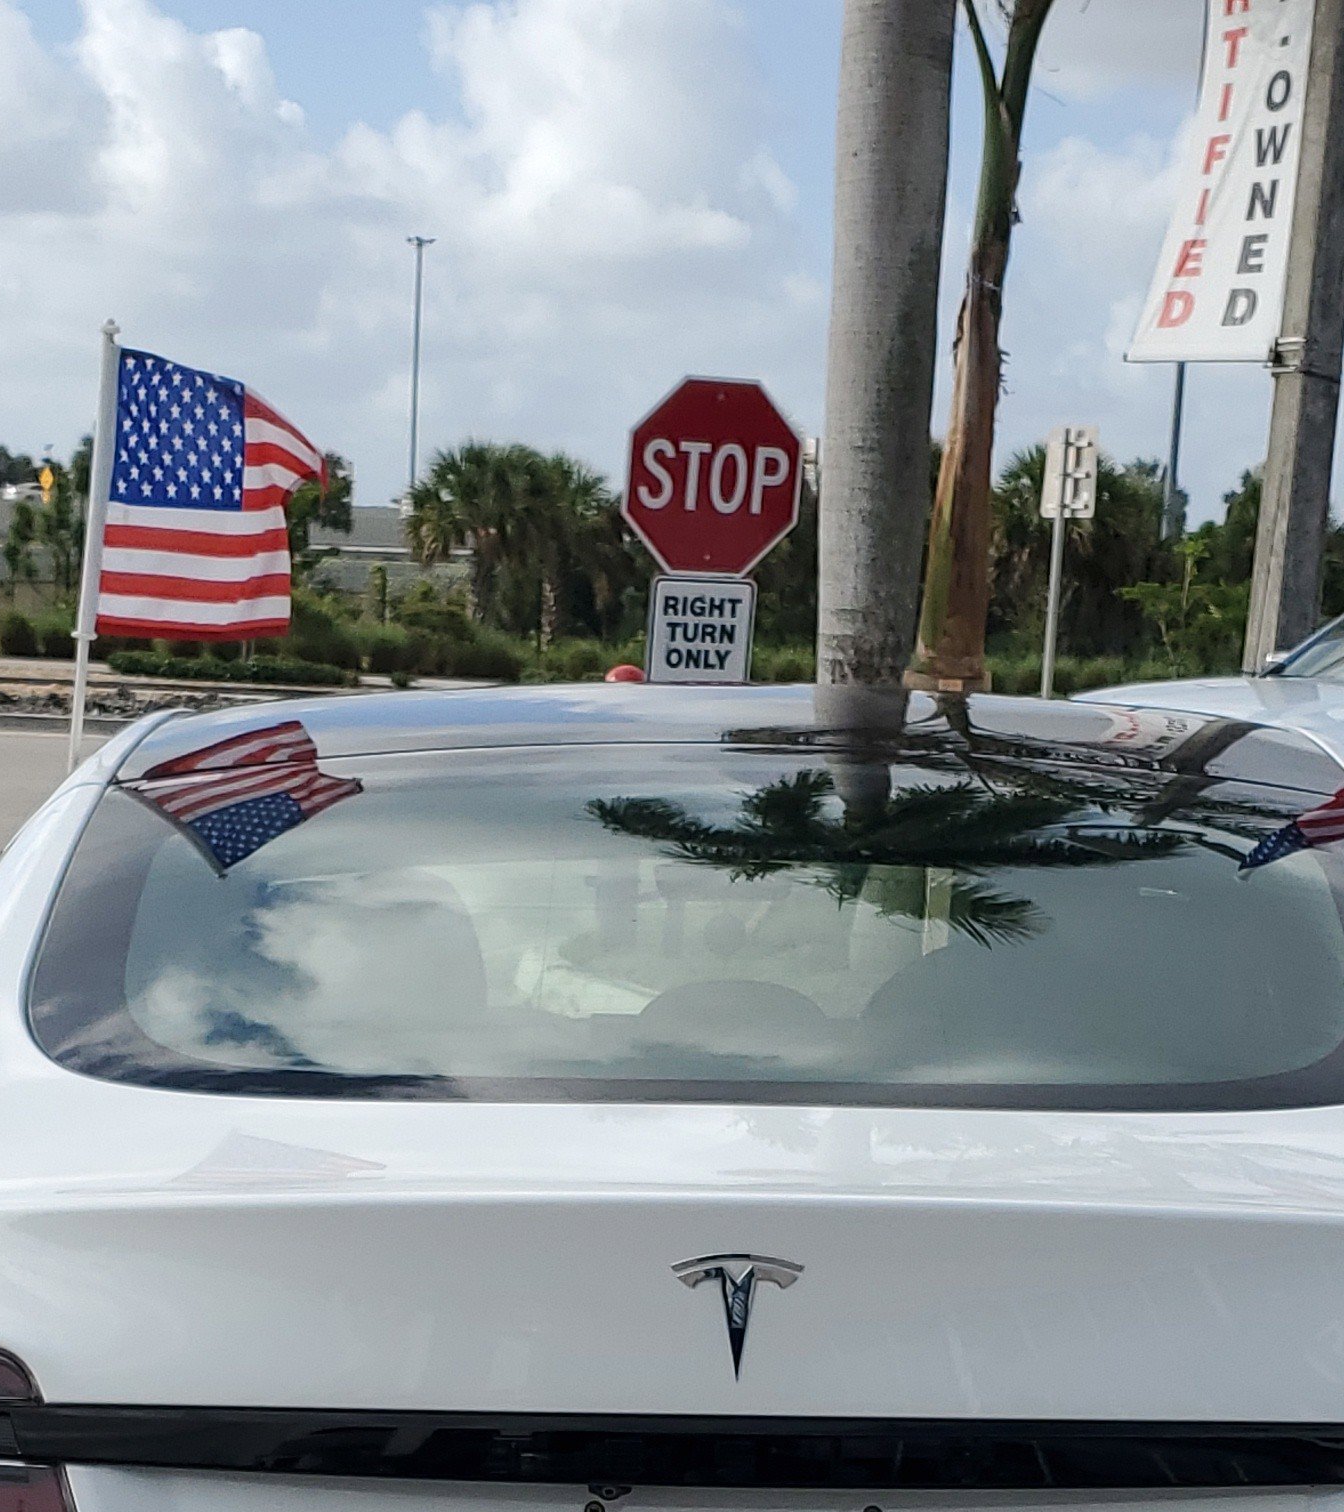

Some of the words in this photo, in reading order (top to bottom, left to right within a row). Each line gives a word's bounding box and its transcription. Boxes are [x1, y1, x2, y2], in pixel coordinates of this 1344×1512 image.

[637, 438, 790, 515] STOP
[663, 596, 743, 618] RIGHT
[666, 622, 736, 644] TURN
[666, 648, 732, 670] ONLY
